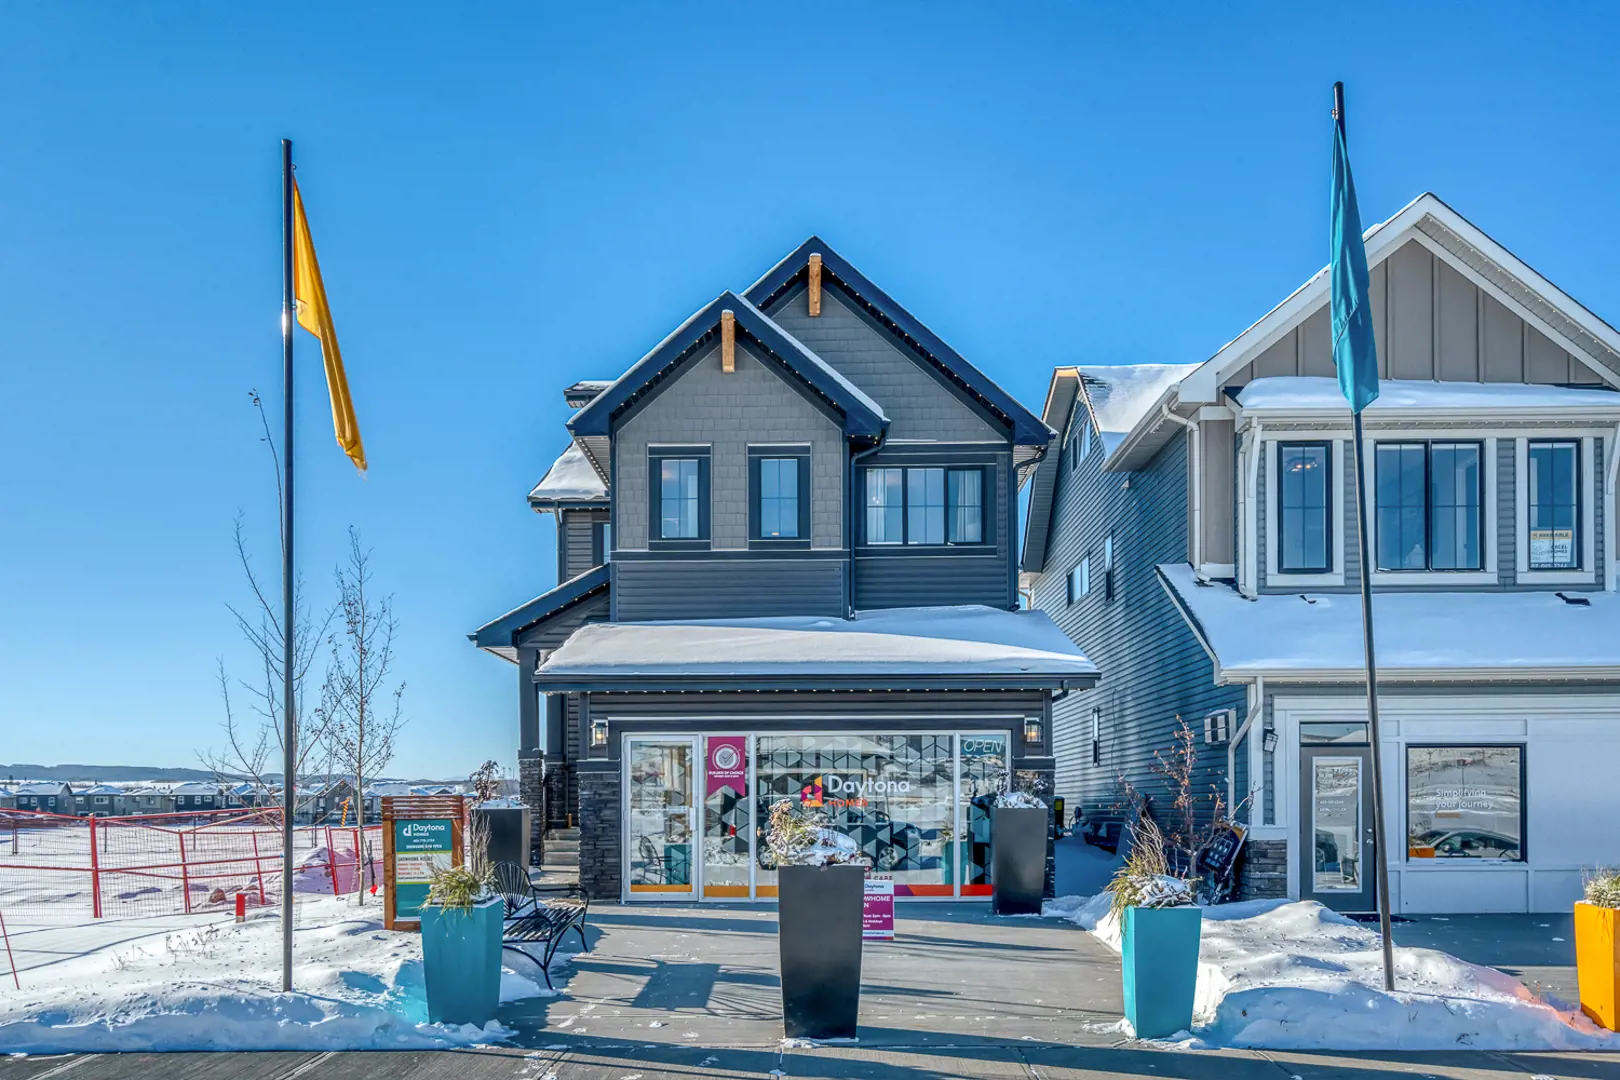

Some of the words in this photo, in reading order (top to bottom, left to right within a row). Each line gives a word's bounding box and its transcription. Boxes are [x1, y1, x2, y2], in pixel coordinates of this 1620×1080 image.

[963, 739, 1003, 753] OPEN
[827, 775, 910, 797] Daytona
[1435, 788, 1486, 798] Simplifying
[827, 799, 868, 807] HOMES
[1435, 801, 1457, 810] your
[1458, 800, 1494, 810] journey
[413, 824, 445, 833] Daytona
